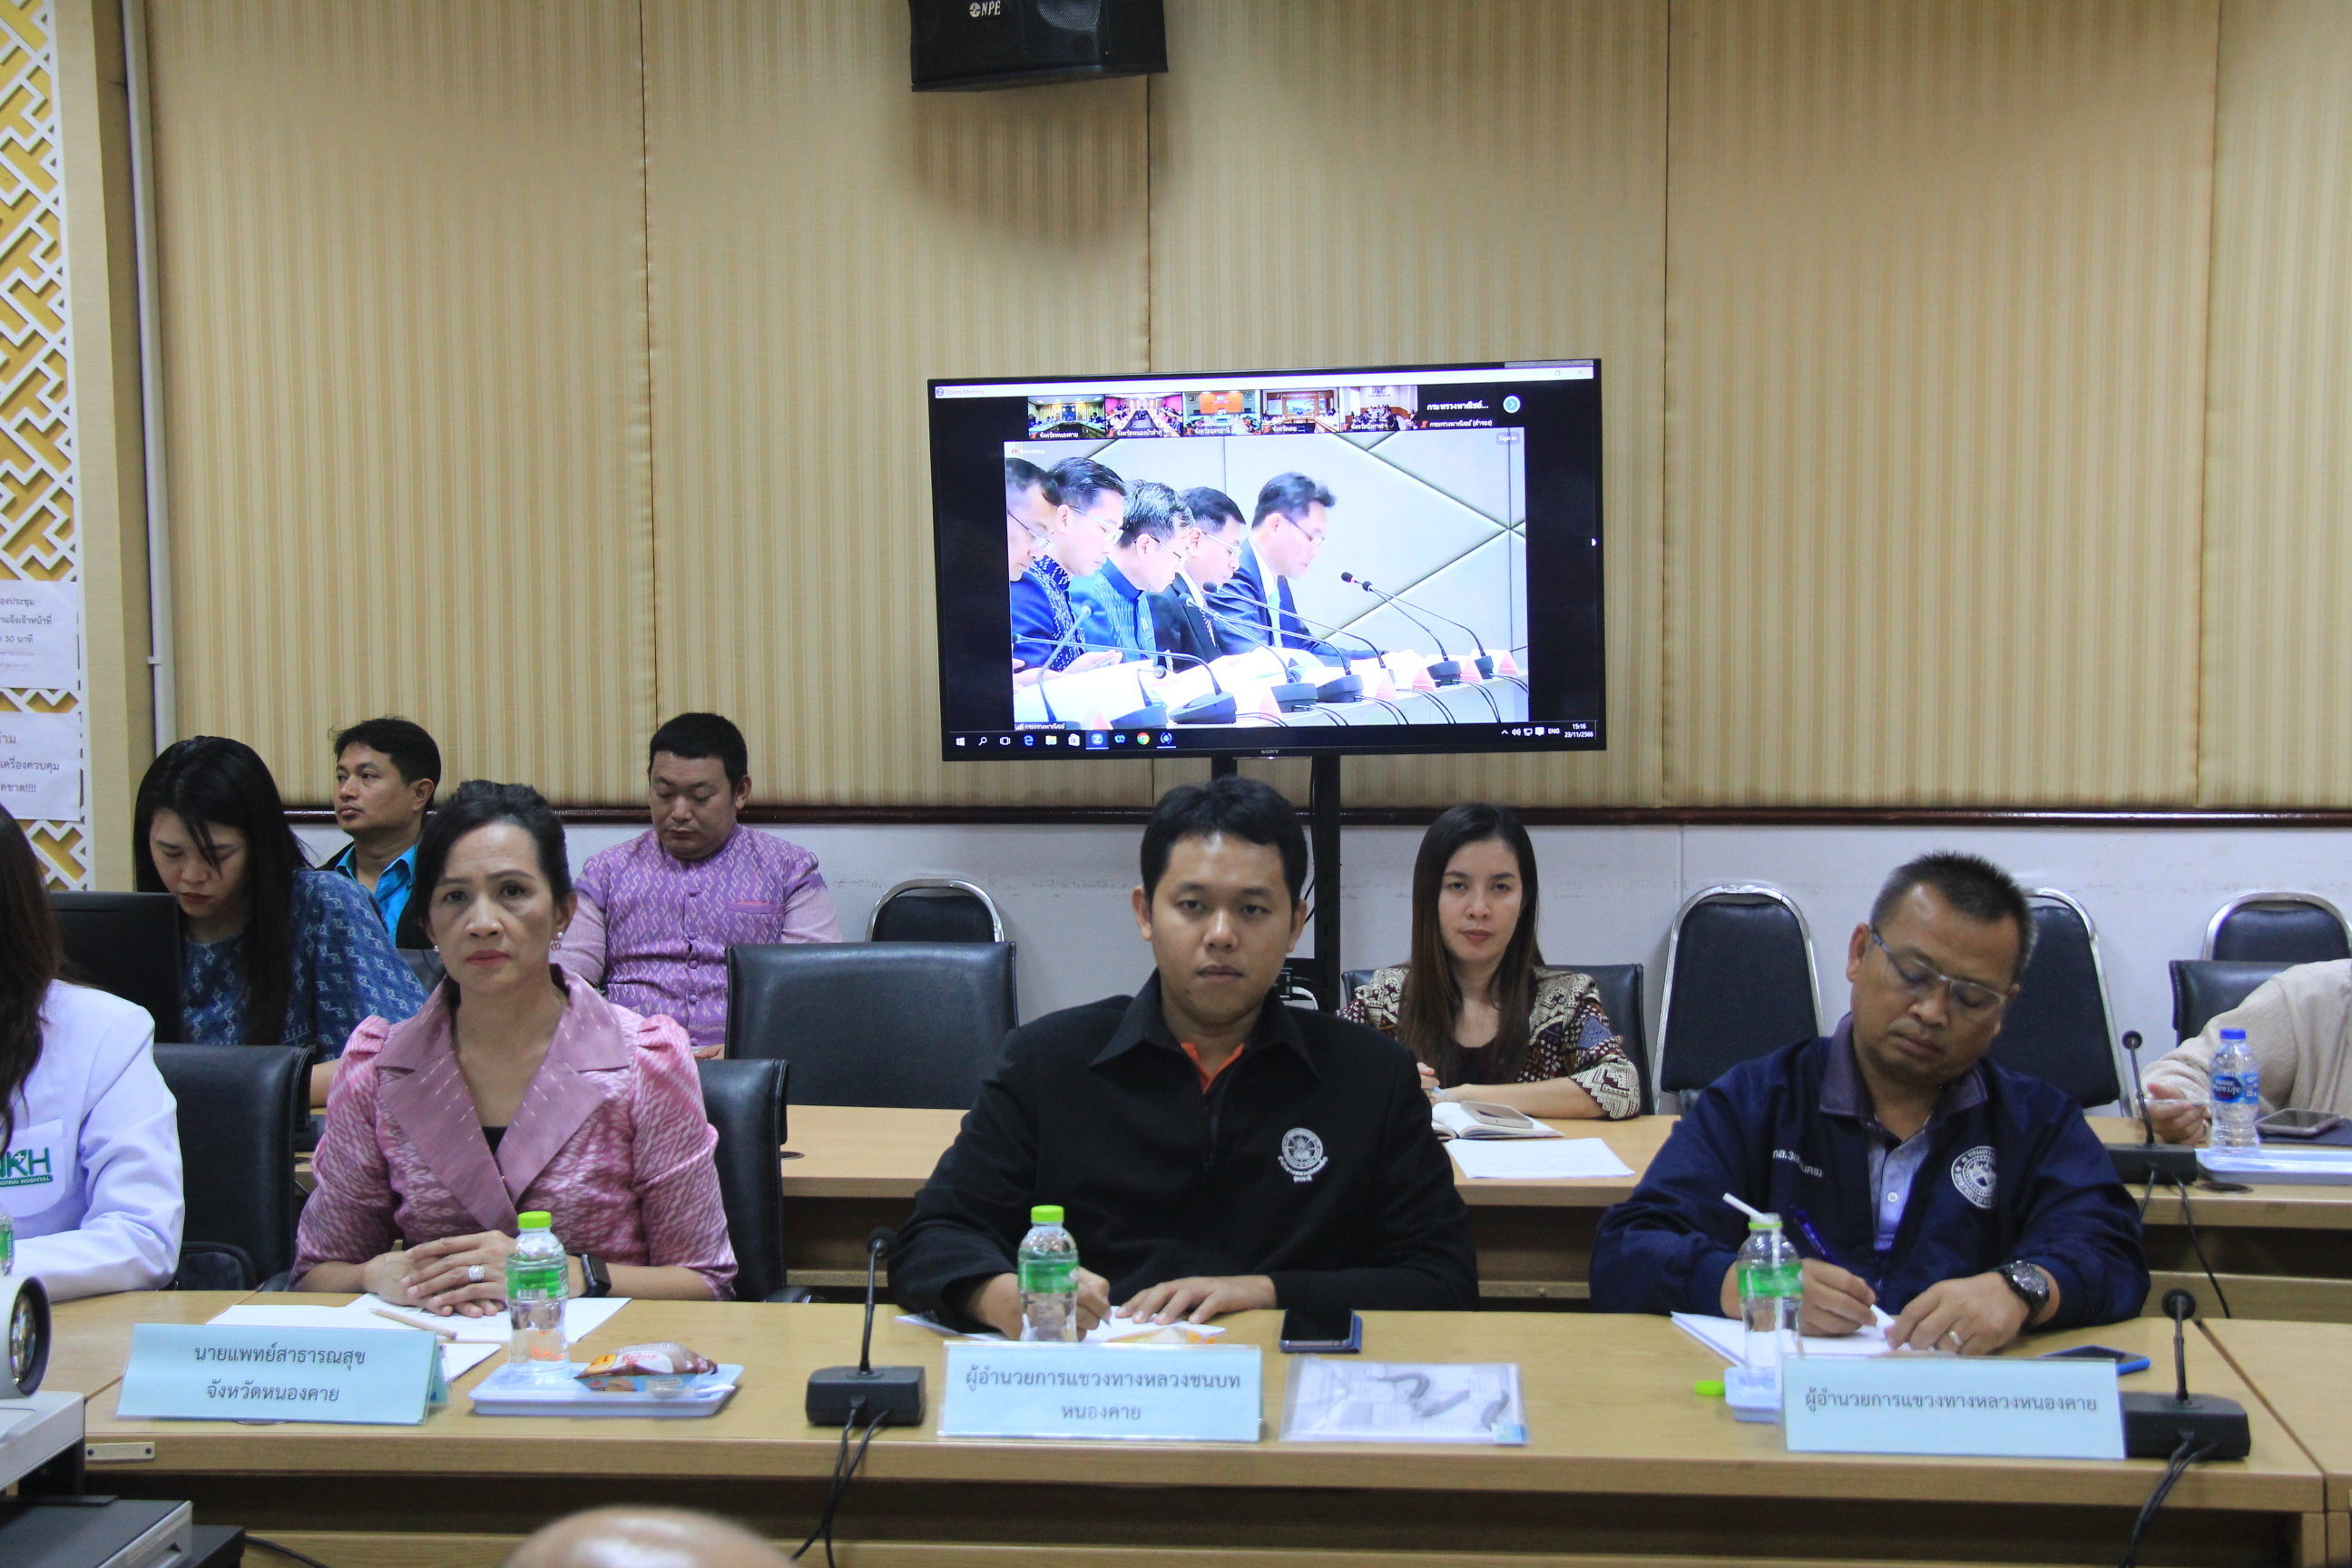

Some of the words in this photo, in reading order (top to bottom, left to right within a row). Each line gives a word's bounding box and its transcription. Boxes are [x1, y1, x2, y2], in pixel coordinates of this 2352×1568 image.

[5, 635, 15, 643] 30
[21, 1176, 51, 1184] HOSPITAL
[195, 1341, 366, 1371] นายแพทย์สาธารณสุข
[206, 1378, 340, 1402] จังหวัดหนองคาย
[965, 1365, 1240, 1391] ผู้อำนวยการแขวงทางหลวงชนบท
[1804, 1387, 2097, 1412] ผู้อำนวยการแขวงทางหลวงหนองคาย
[1062, 1404, 1142, 1421] หนองคาย
